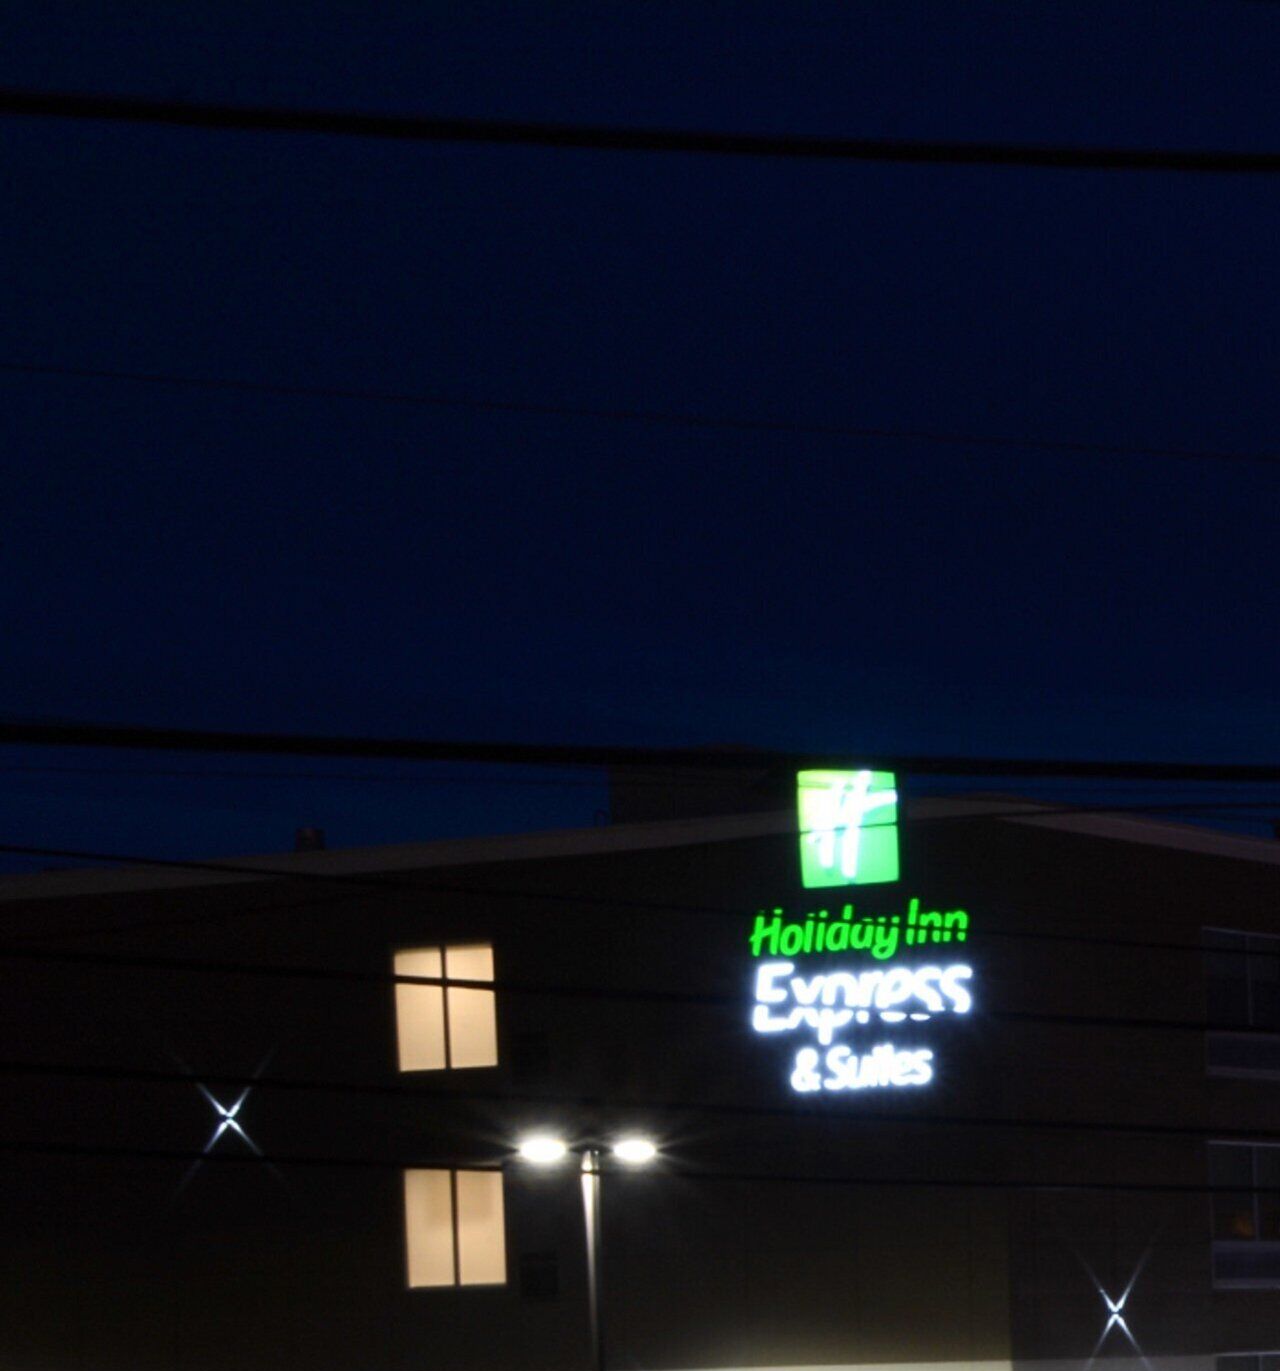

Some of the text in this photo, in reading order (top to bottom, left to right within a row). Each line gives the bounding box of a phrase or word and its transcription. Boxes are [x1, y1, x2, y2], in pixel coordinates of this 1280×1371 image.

[750, 898, 969, 961] Holiday Inn
[751, 961, 973, 1046] Express
[790, 1043, 934, 1093] & Suites
